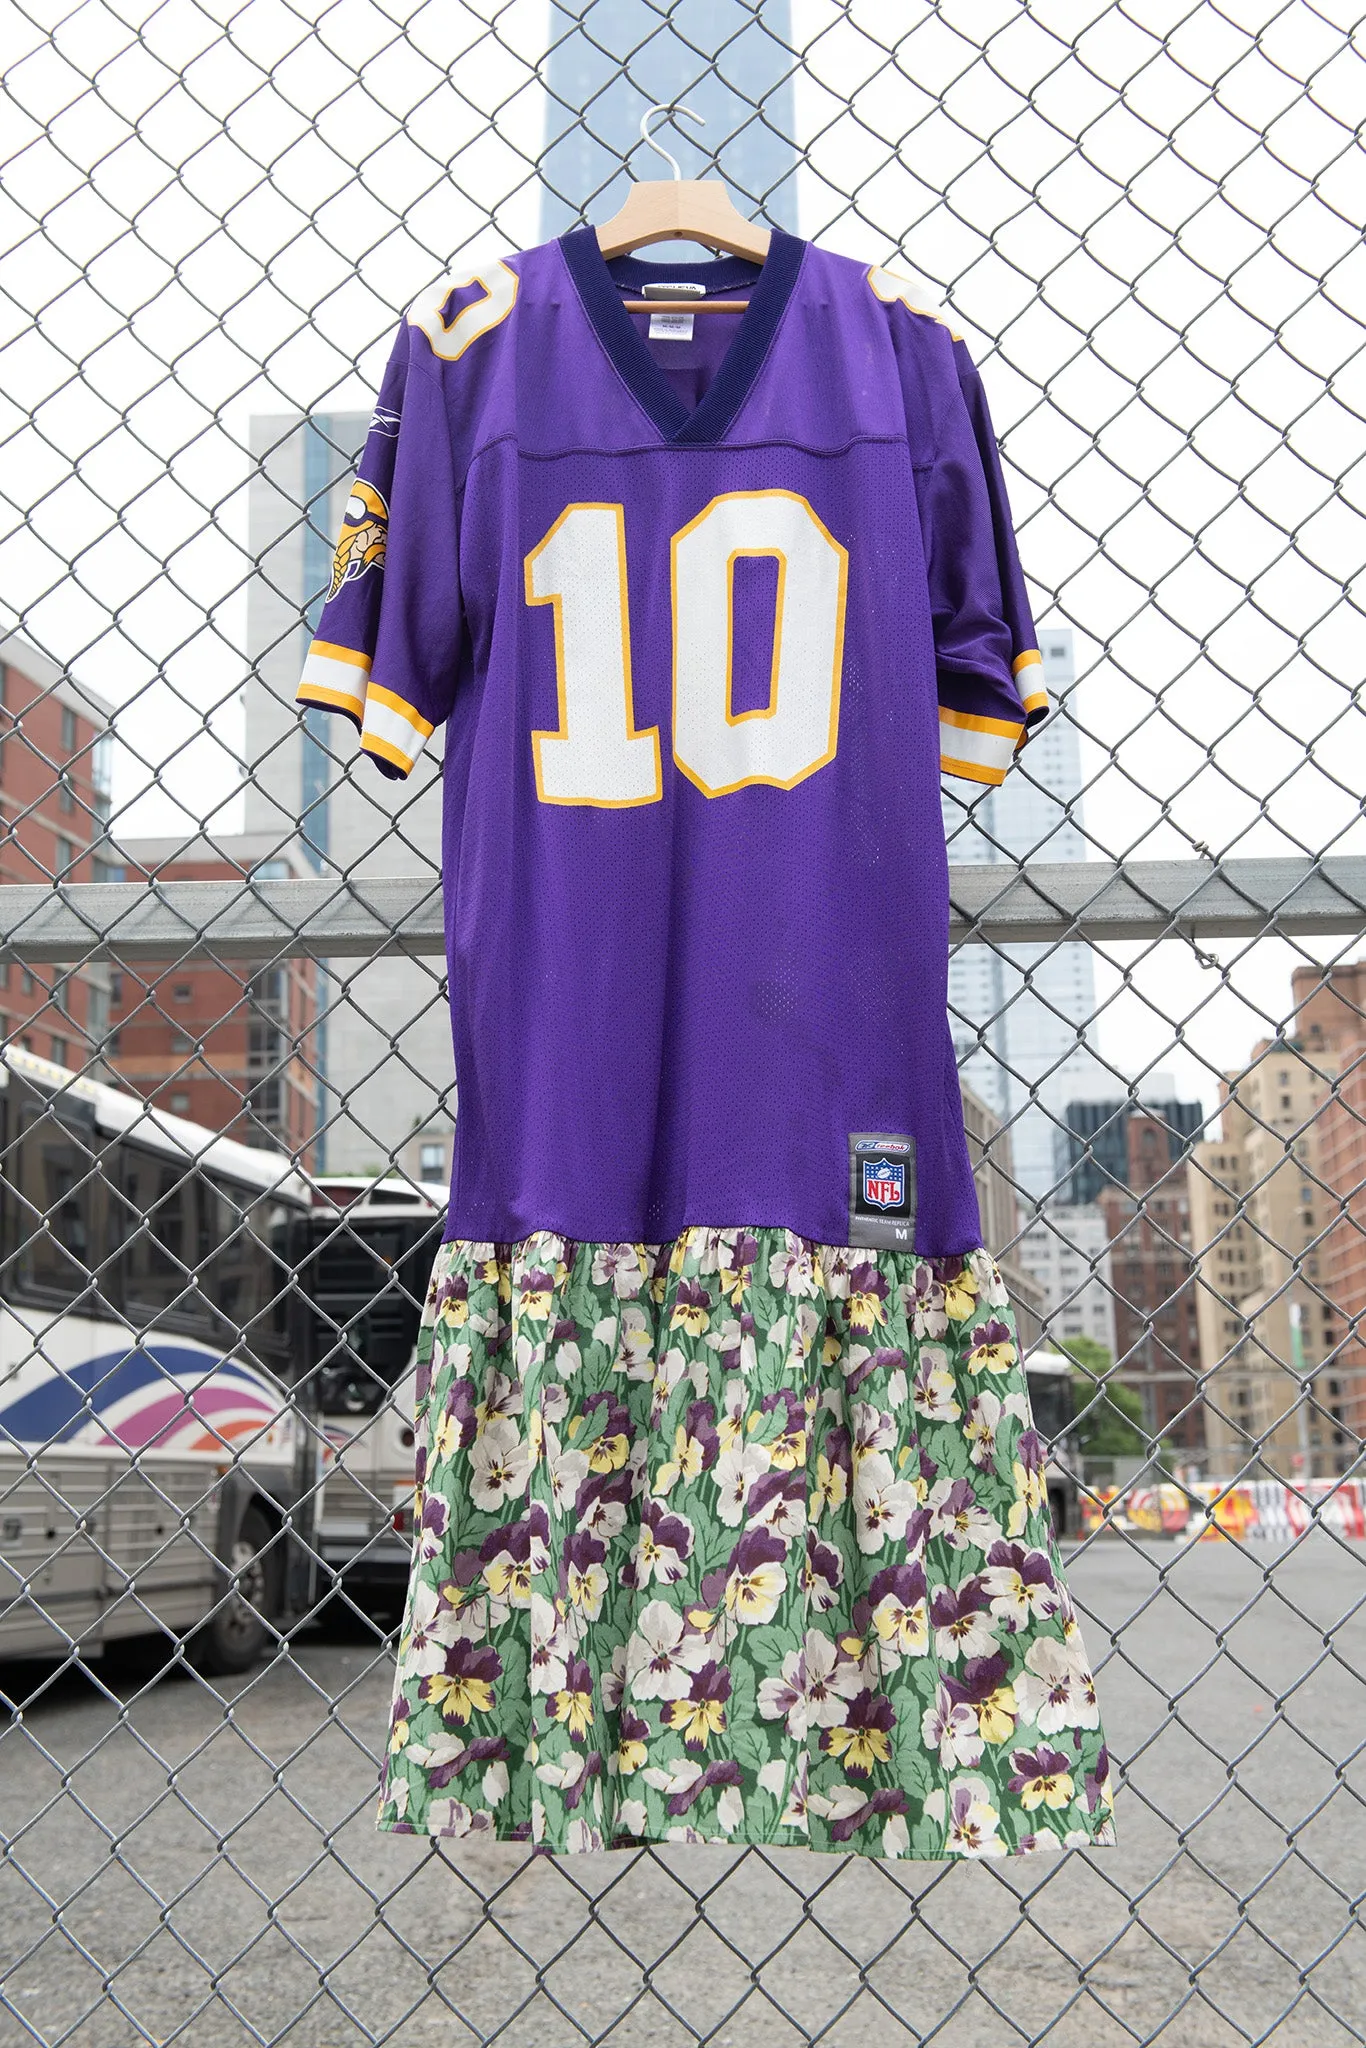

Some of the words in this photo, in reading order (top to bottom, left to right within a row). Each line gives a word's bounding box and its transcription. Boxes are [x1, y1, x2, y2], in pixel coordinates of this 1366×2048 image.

[523, 488, 849, 809] 10
[867, 1180, 900, 1204] NFL
[895, 1228, 908, 1241] M
